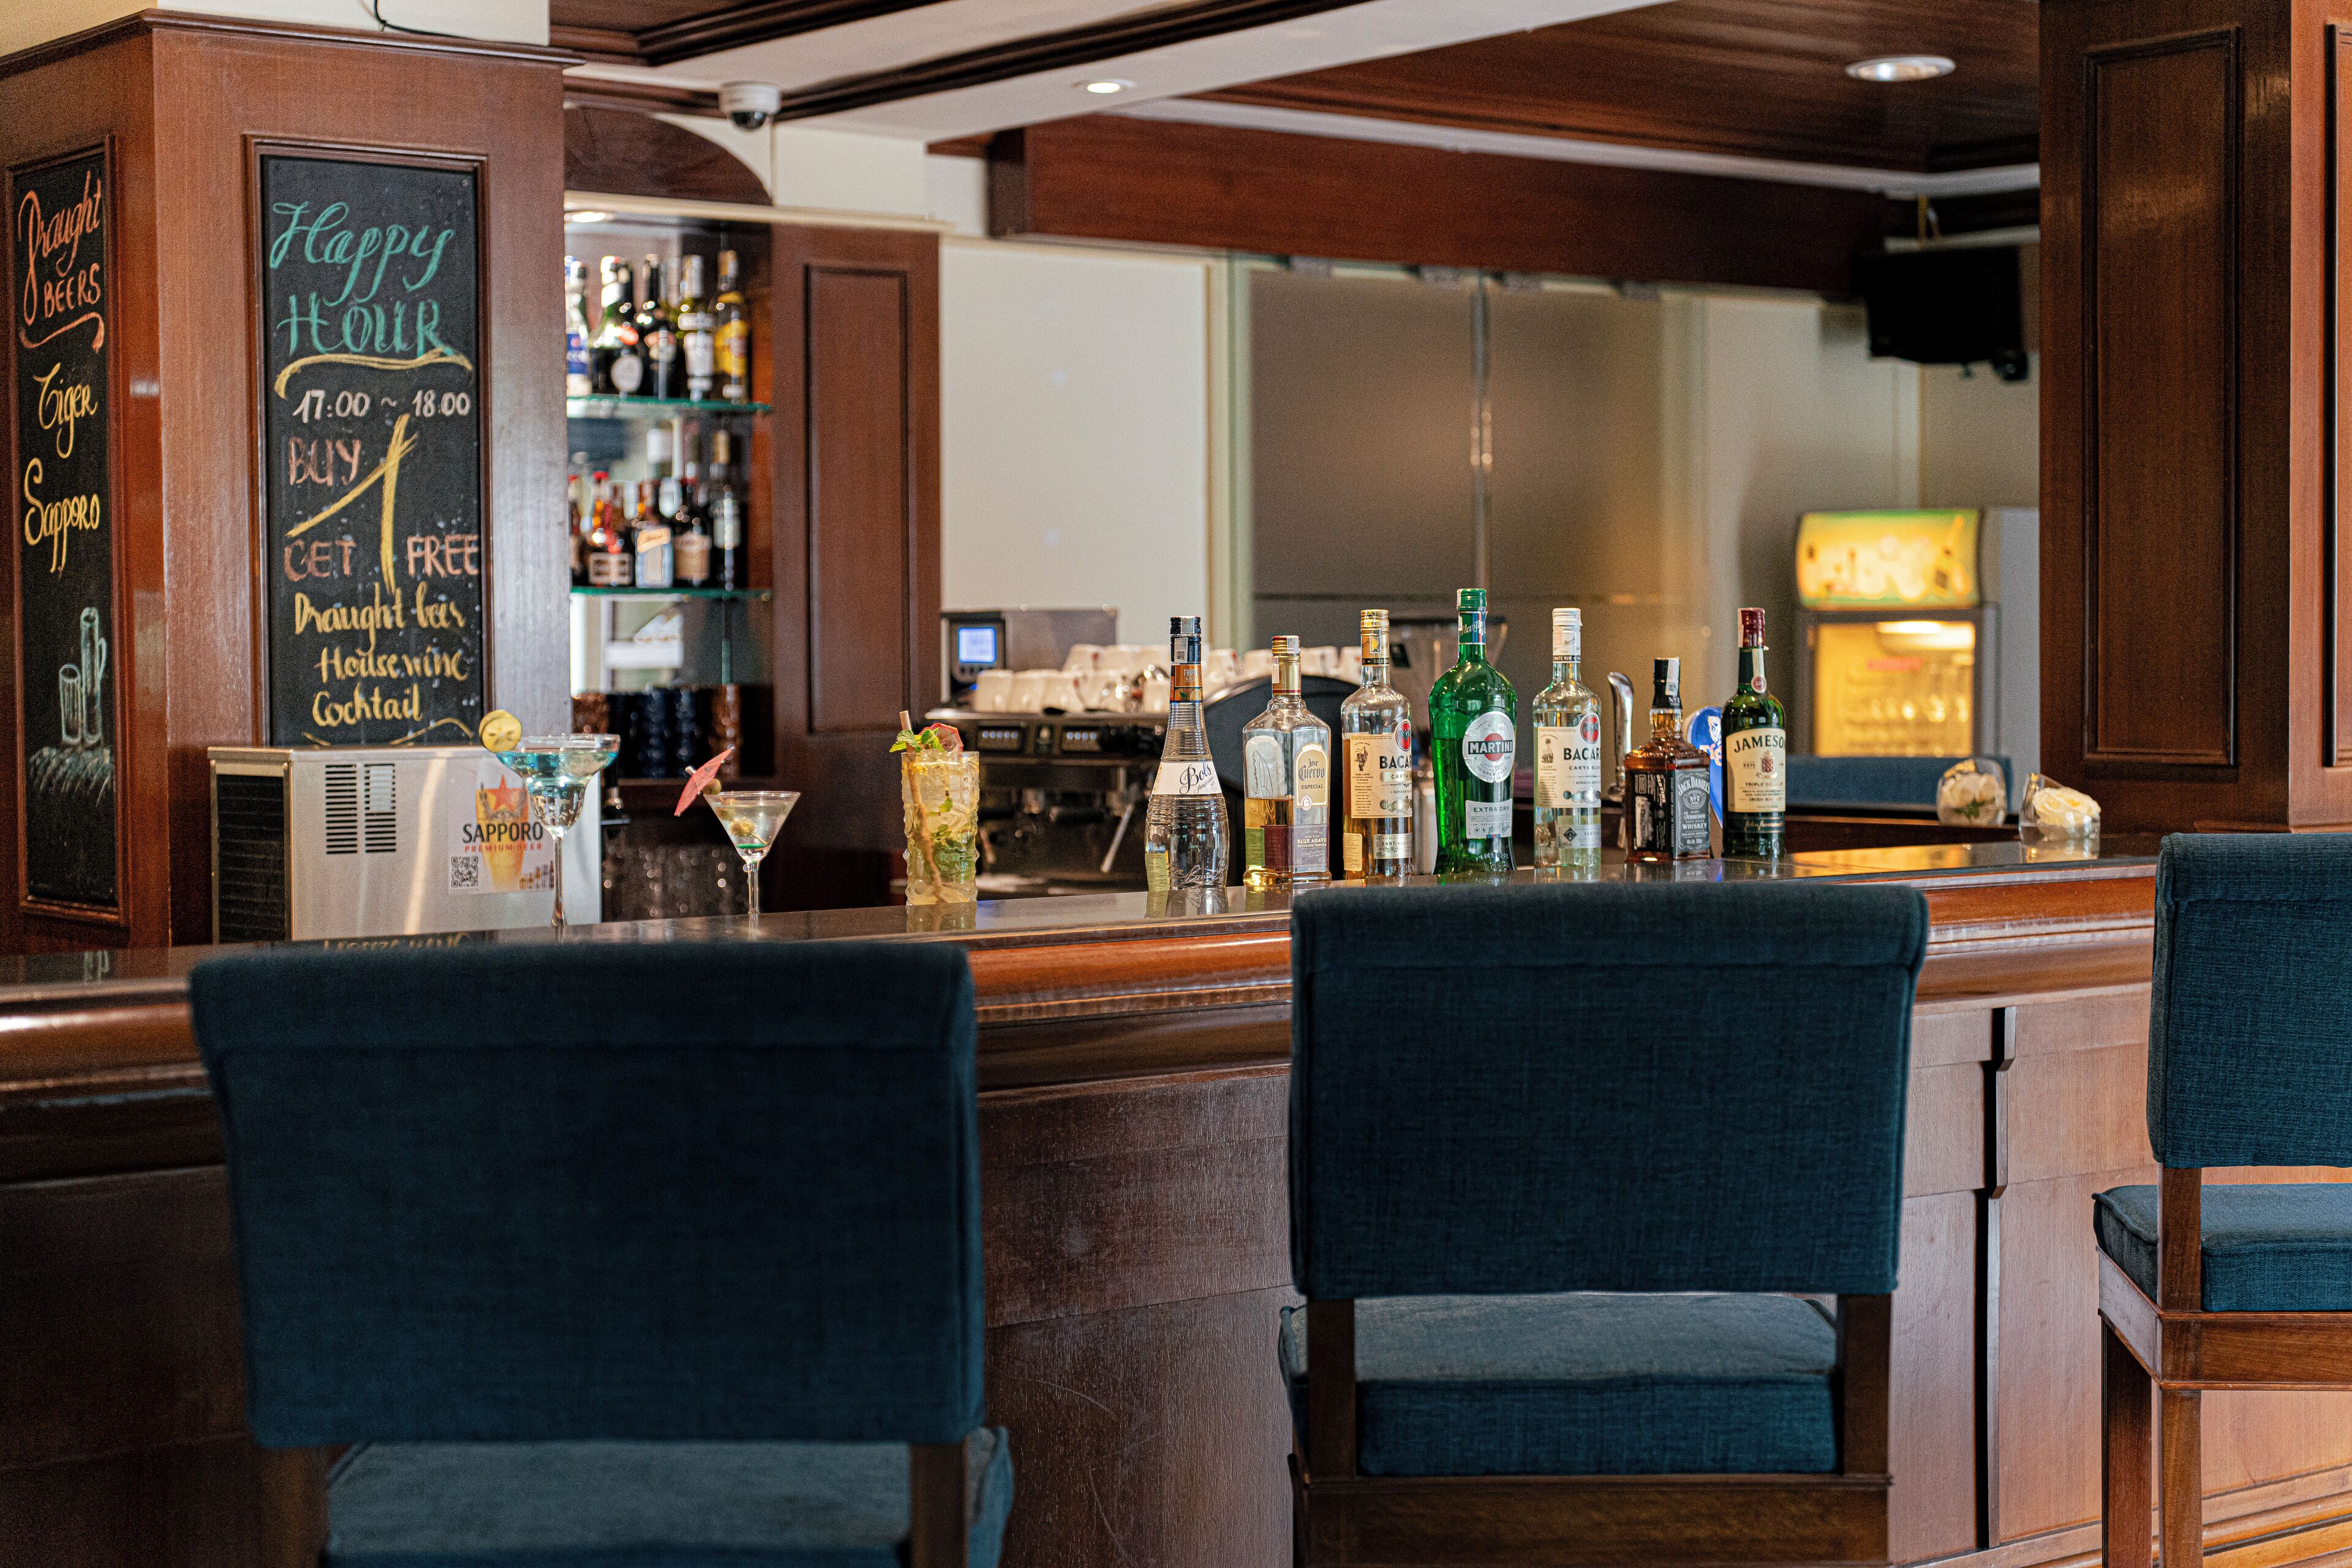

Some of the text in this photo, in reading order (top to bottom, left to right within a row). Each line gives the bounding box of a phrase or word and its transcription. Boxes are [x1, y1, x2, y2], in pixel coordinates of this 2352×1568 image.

[18, 170, 102, 326] Draught
[270, 201, 455, 307] Happy
[43, 262, 100, 318] BEERS
[277, 292, 456, 358] HOUR
[33, 362, 98, 459] Tiger
[292, 389, 371, 424] 17:00
[412, 389, 472, 418] 18:00
[288, 437, 362, 487] BUY
[24, 457, 100, 575] Sapporo
[284, 533, 480, 582] GET FREE
[295, 581, 405, 654] Draught
[312, 682, 423, 727] Cocktail
[1470, 741, 1512, 753] MARTINI
[1179, 759, 1212, 794] Bols
[1298, 764, 1325, 782] Cuervo
[1678, 779, 1692, 796] JACK
[462, 821, 543, 843] SAPPORO
[464, 842, 543, 853] PREMIUM BEER
